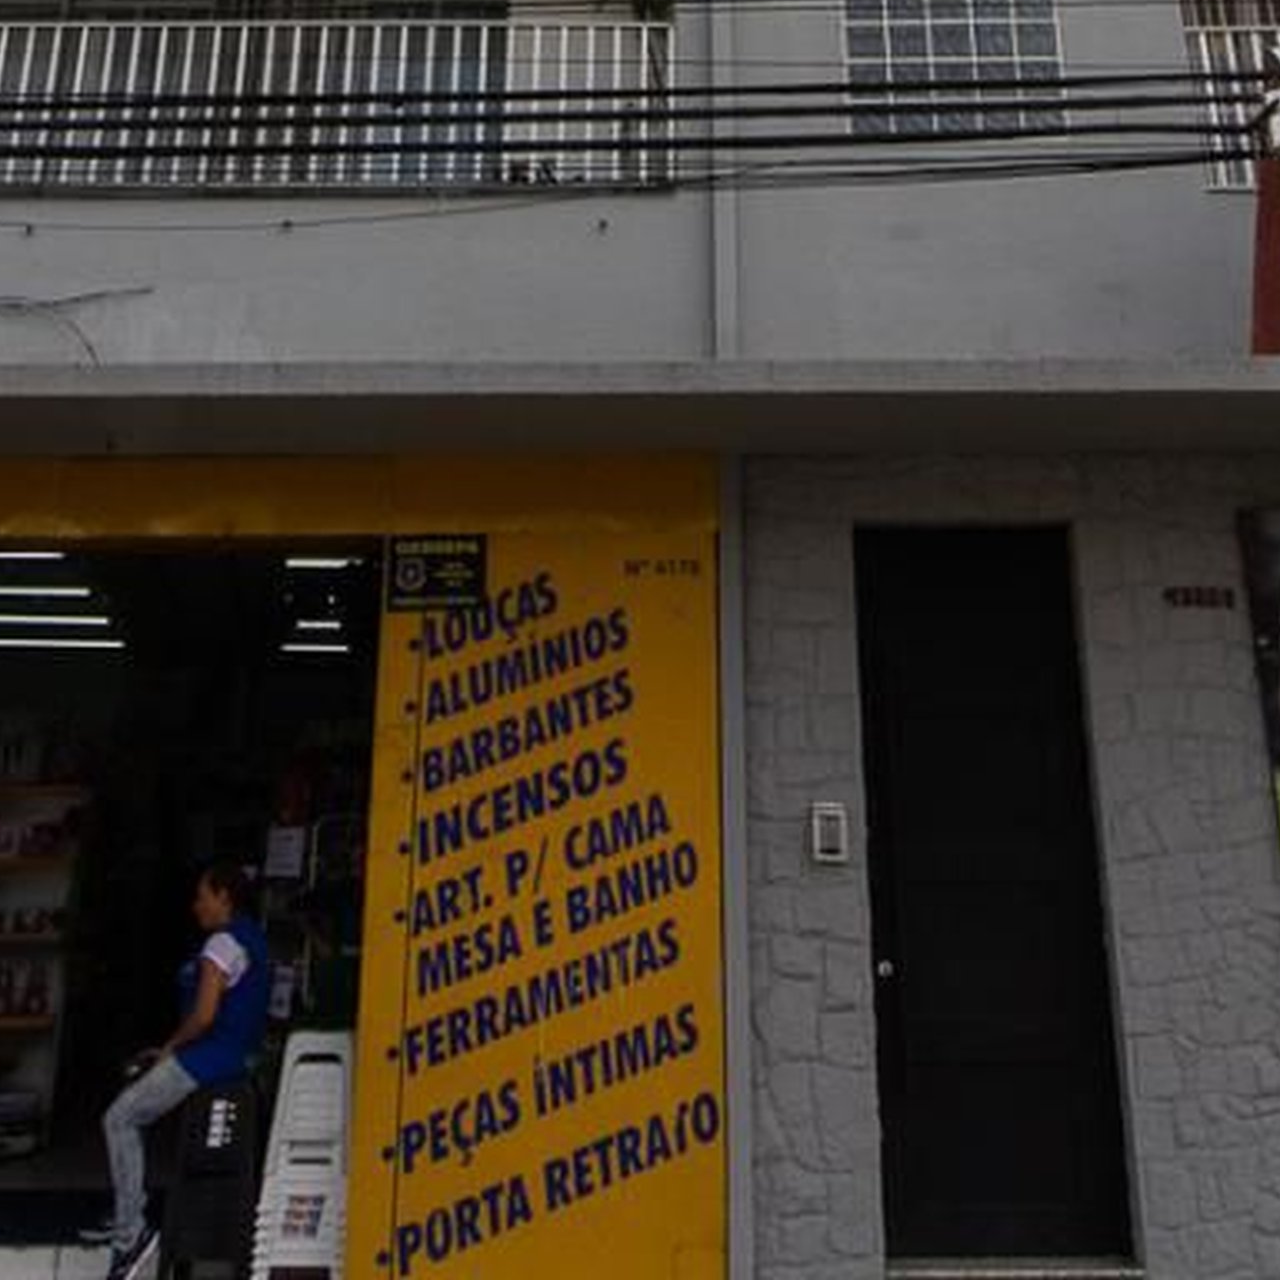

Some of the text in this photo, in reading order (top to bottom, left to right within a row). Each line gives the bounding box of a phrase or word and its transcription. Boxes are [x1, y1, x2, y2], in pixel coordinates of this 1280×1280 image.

[424, 572, 558, 657] LOUÇAS
[425, 607, 630, 724] ALUMÍNIOS
[423, 668, 632, 792] BARBANTES
[411, 792, 670, 937] ART. P/ CAMA
[419, 737, 628, 865] INCENSOS
[417, 841, 698, 997] MESA E BANHO
[405, 917, 681, 1075] FERRAMENTAS
[400, 1003, 699, 1174] PEÇAS ÍNTIMAS
[396, 1174, 533, 1277] PORTA
